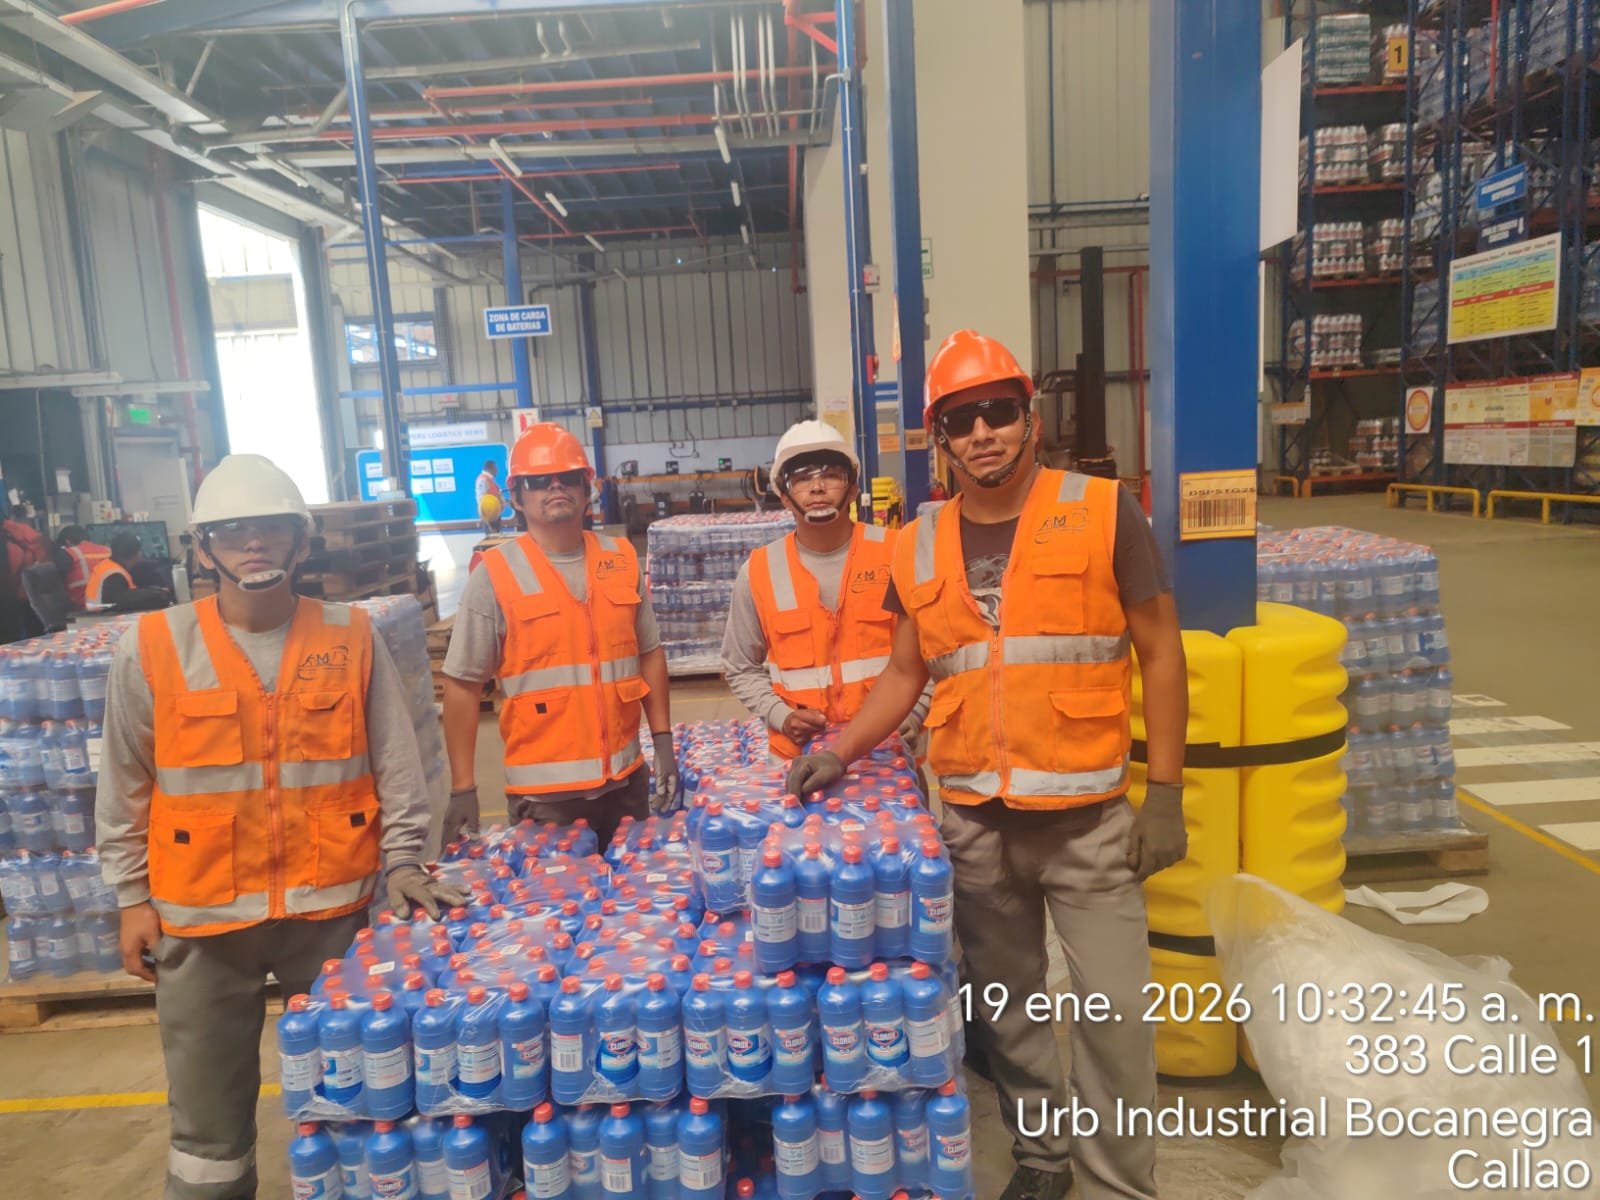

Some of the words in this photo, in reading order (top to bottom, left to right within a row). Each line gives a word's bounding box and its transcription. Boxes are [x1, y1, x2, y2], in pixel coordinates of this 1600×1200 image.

[1394, 45, 1402, 64] 1
[489, 312, 509, 323] ZONA
[510, 311, 520, 321] DE
